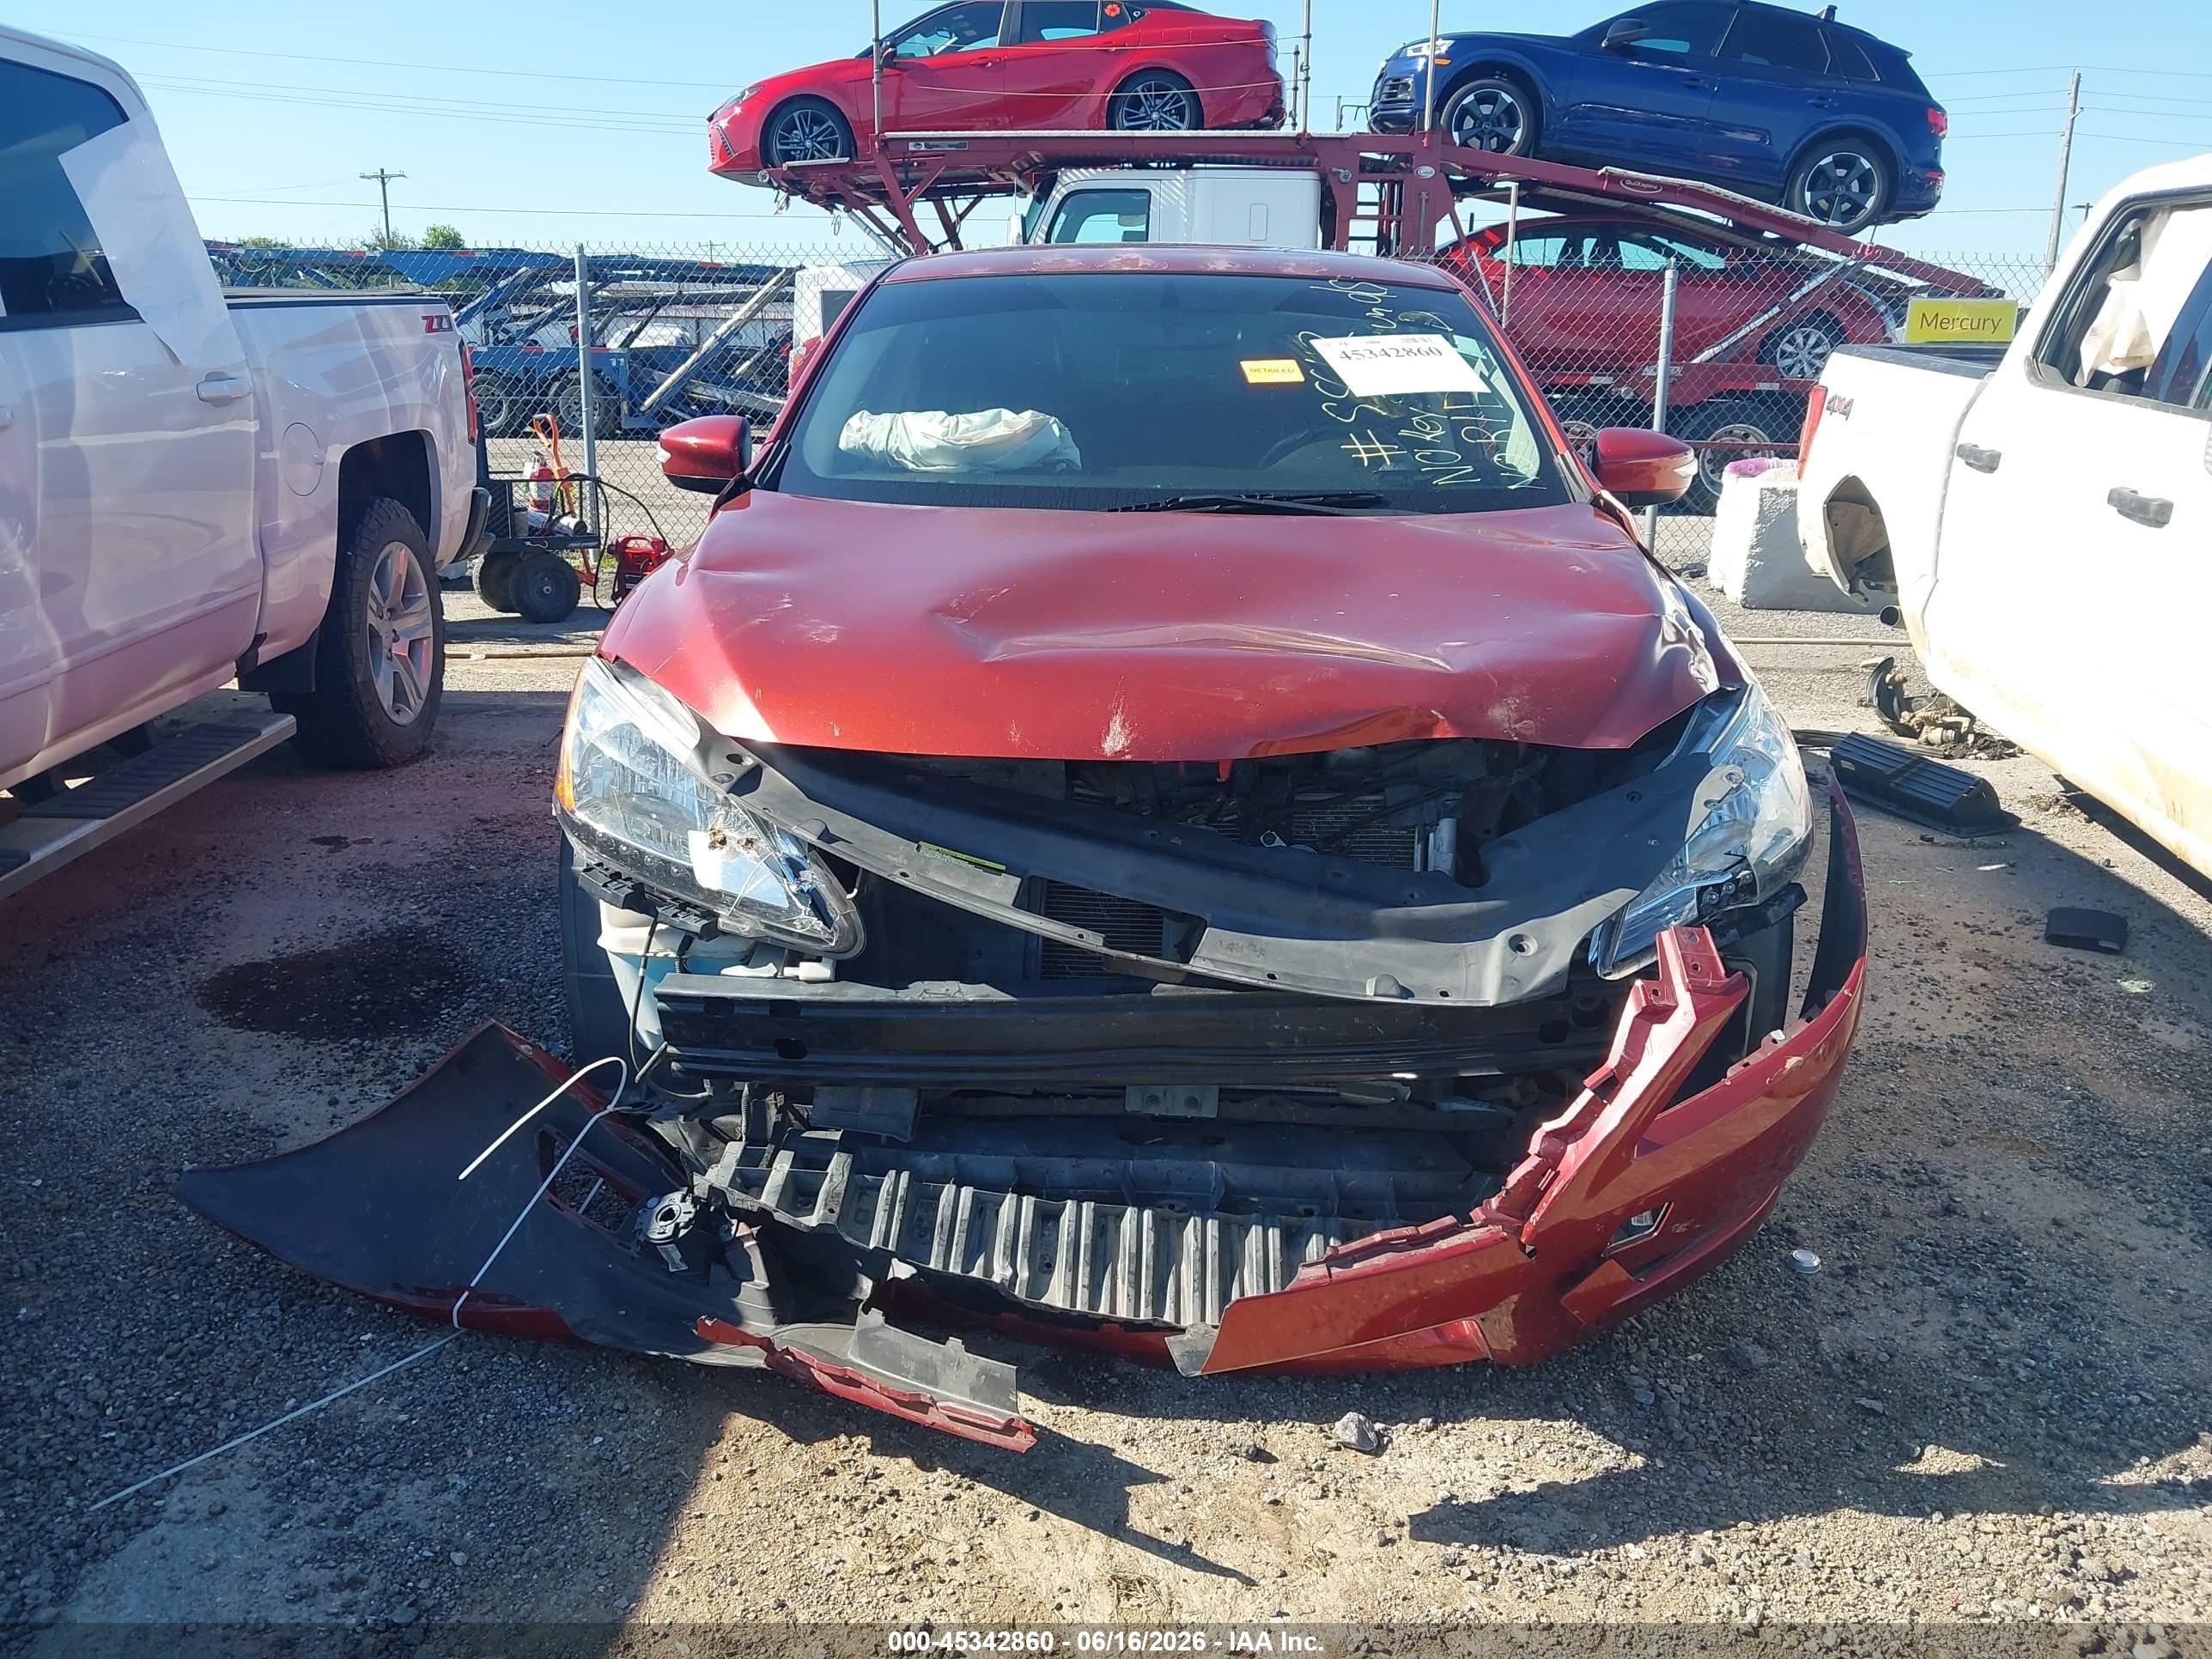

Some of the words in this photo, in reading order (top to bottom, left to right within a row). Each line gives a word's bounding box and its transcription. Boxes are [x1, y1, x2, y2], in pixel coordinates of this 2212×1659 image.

[1919, 312, 2002, 335] Mercury
[1339, 346, 1443, 361] 45342860
[1413, 448, 1482, 486] NO
